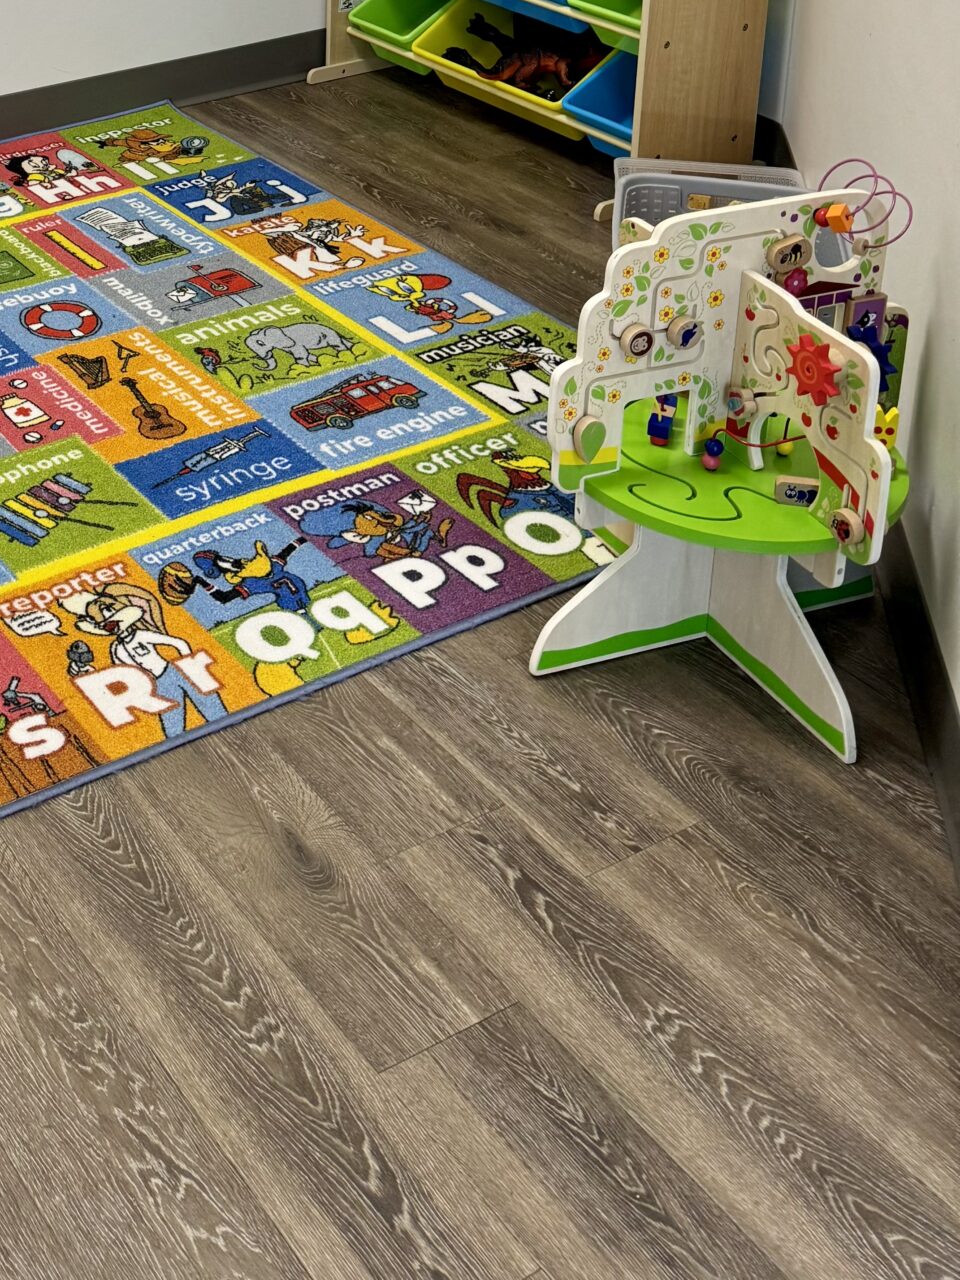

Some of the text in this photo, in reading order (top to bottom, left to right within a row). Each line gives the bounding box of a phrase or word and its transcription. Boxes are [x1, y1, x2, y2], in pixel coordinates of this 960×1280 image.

[75, 116, 173, 144] inspector
[154, 173, 218, 196] judge
[21, 217, 62, 234] ruler
[123, 196, 215, 256] typewriter
[223, 214, 296, 238] karate
[103, 277, 174, 325] mailbox
[313, 259, 419, 296] lifeguard
[175, 301, 302, 345] animals
[418, 324, 529, 363] musician
[127, 331, 247, 422] instruments
[137, 367, 224, 427] musical
[32, 370, 109, 435] medicine
[319, 404, 469, 458] fire engine
[415, 431, 520, 475] officer
[175, 454, 292, 503] syringe
[283, 470, 401, 520] postman
[142, 510, 271, 567] quarterback
[0, 561, 128, 617] reporter
